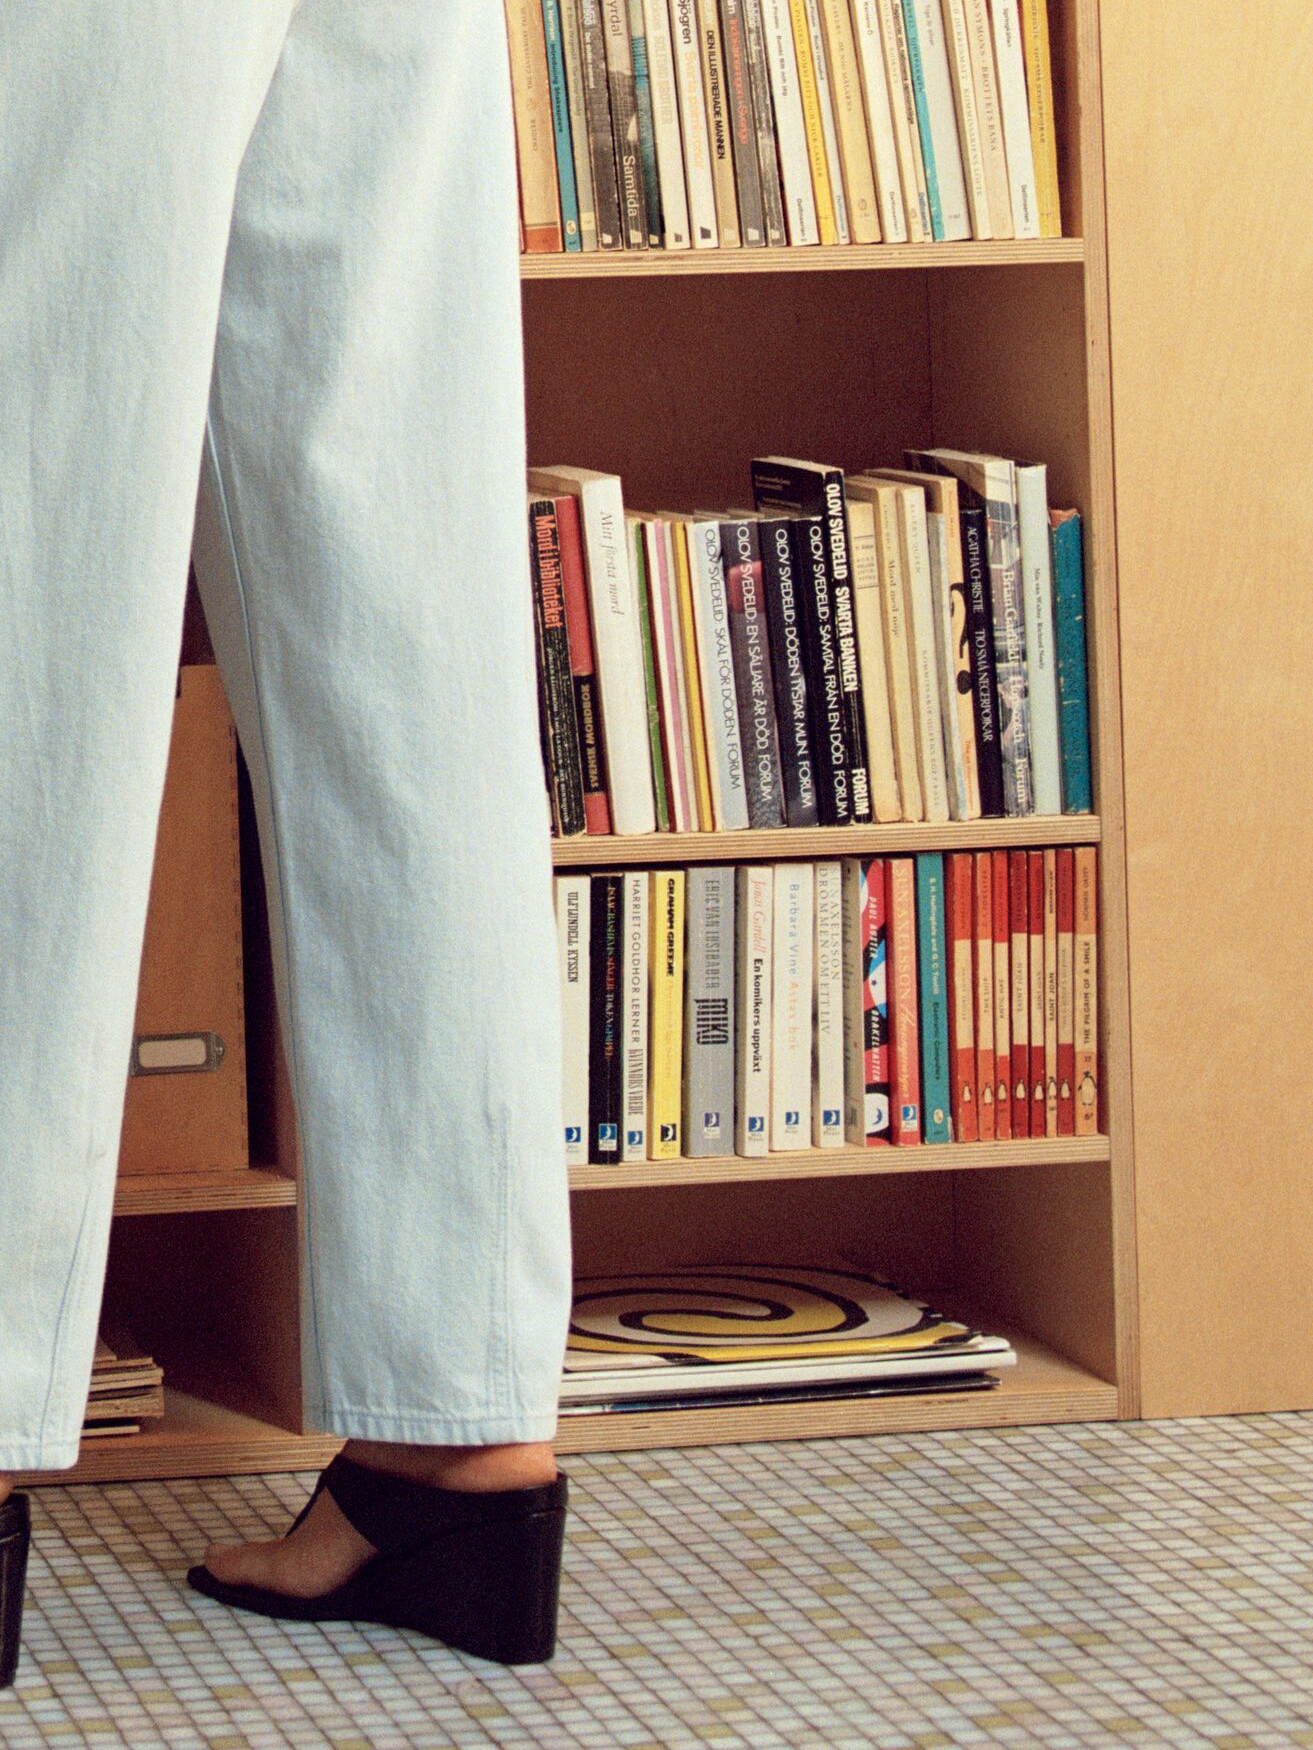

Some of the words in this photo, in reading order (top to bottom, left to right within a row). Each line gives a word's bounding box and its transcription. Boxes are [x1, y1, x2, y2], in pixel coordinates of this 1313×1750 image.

[707, 30, 716, 48] DEN
[708, 50, 722, 117] ILLUSTRERADE
[715, 120, 726, 159] MANNEN
[623, 155, 638, 216] Samtida
[826, 483, 840, 516] OLOV
[536, 514, 556, 549] Mord
[776, 529, 789, 565] OLOV
[829, 518, 848, 579] SVEDELID
[541, 559, 564, 628] biblioteket
[740, 564, 757, 623] SVEDELID:
[835, 586, 853, 636] SVARTA
[746, 627, 757, 644] EN
[785, 627, 802, 676] DÖDEN
[820, 625, 835, 672] SAMTAL
[748, 646, 765, 696] SÄLJARE
[840, 638, 859, 692] BANKEN
[581, 684, 594, 743] MORDBOK
[753, 699, 767, 716] ÄR
[791, 678, 805, 719] TYSTAR
[825, 675, 840, 709] FRÅN
[719, 659, 732, 684] FÖR
[727, 743, 741, 790] FORUM
[829, 712, 840, 730] EN
[585, 747, 599, 788] SVENSK
[1015, 757, 1028, 802] Forum
[835, 770, 849, 817] FORUM
[851, 768, 869, 815] FORUM
[632, 879, 641, 927] HARRIET
[667, 878, 675, 928] GRAHAM
[705, 907, 721, 927] VAN
[789, 884, 799, 938] Barbara
[869, 897, 877, 919] PAUL
[631, 932, 641, 993] GOLDHOR
[667, 931, 675, 977] GREENE
[789, 945, 799, 974] Vine
[831, 901, 840, 979] AXELSSON
[568, 949, 578, 982] KYSSEN
[754, 958, 763, 972] En
[820, 955, 829, 977] OM
[754, 975, 763, 1025] komikers
[820, 983, 829, 1007] ETT
[631, 998, 641, 1043] LERNER
[694, 998, 729, 1044] MIKO
[789, 1026, 799, 1050] bok
[821, 1012, 830, 1033] LIV
[752, 1028, 762, 1073] uppväxt
